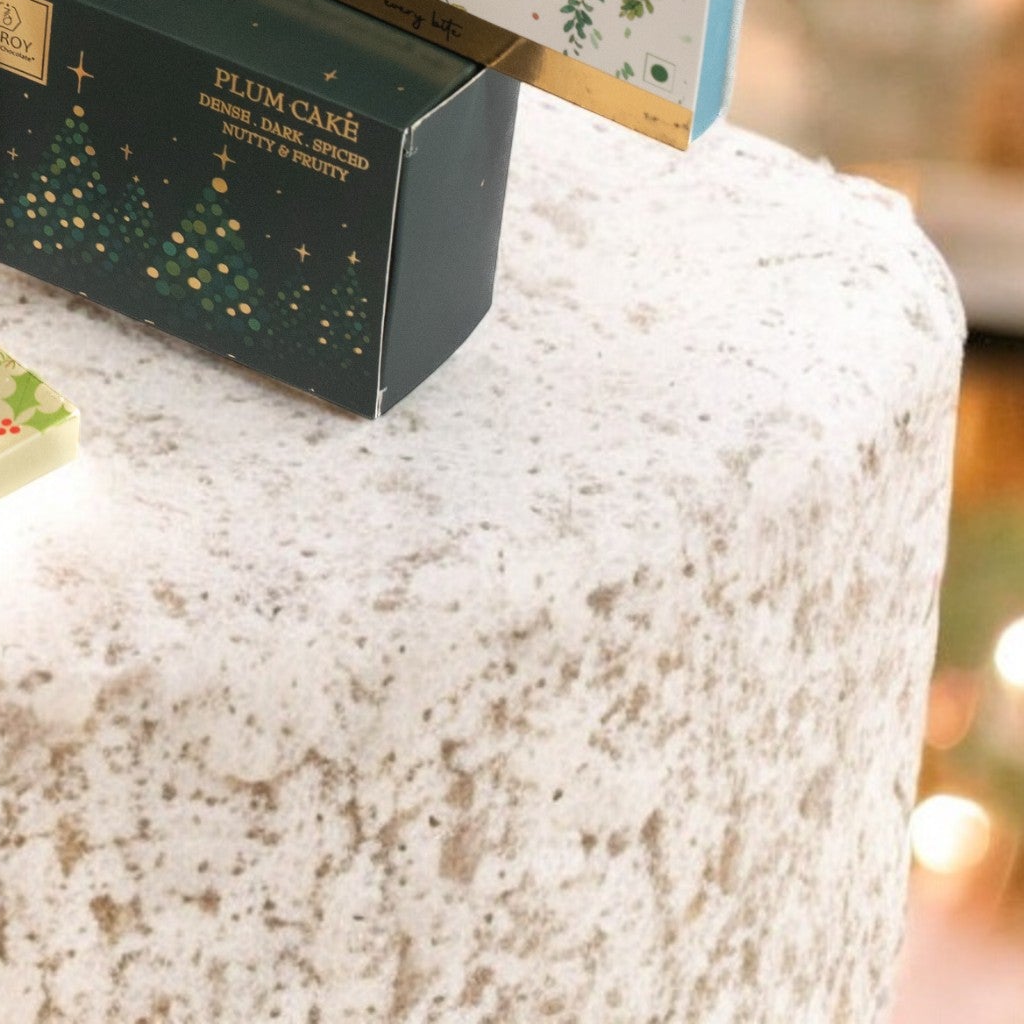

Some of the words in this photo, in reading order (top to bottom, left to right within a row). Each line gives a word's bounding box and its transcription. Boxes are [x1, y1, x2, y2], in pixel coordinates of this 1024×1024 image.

[198, 92, 252, 123] DENSE
[260, 117, 304, 145] DARK
[312, 139, 370, 170] SPICED
[213, 67, 285, 113] PLUM
[290, 100, 359, 143] CAKE
[222, 121, 276, 152] NUTTY
[277, 144, 290, 158] &
[292, 149, 350, 182] FRUITY
